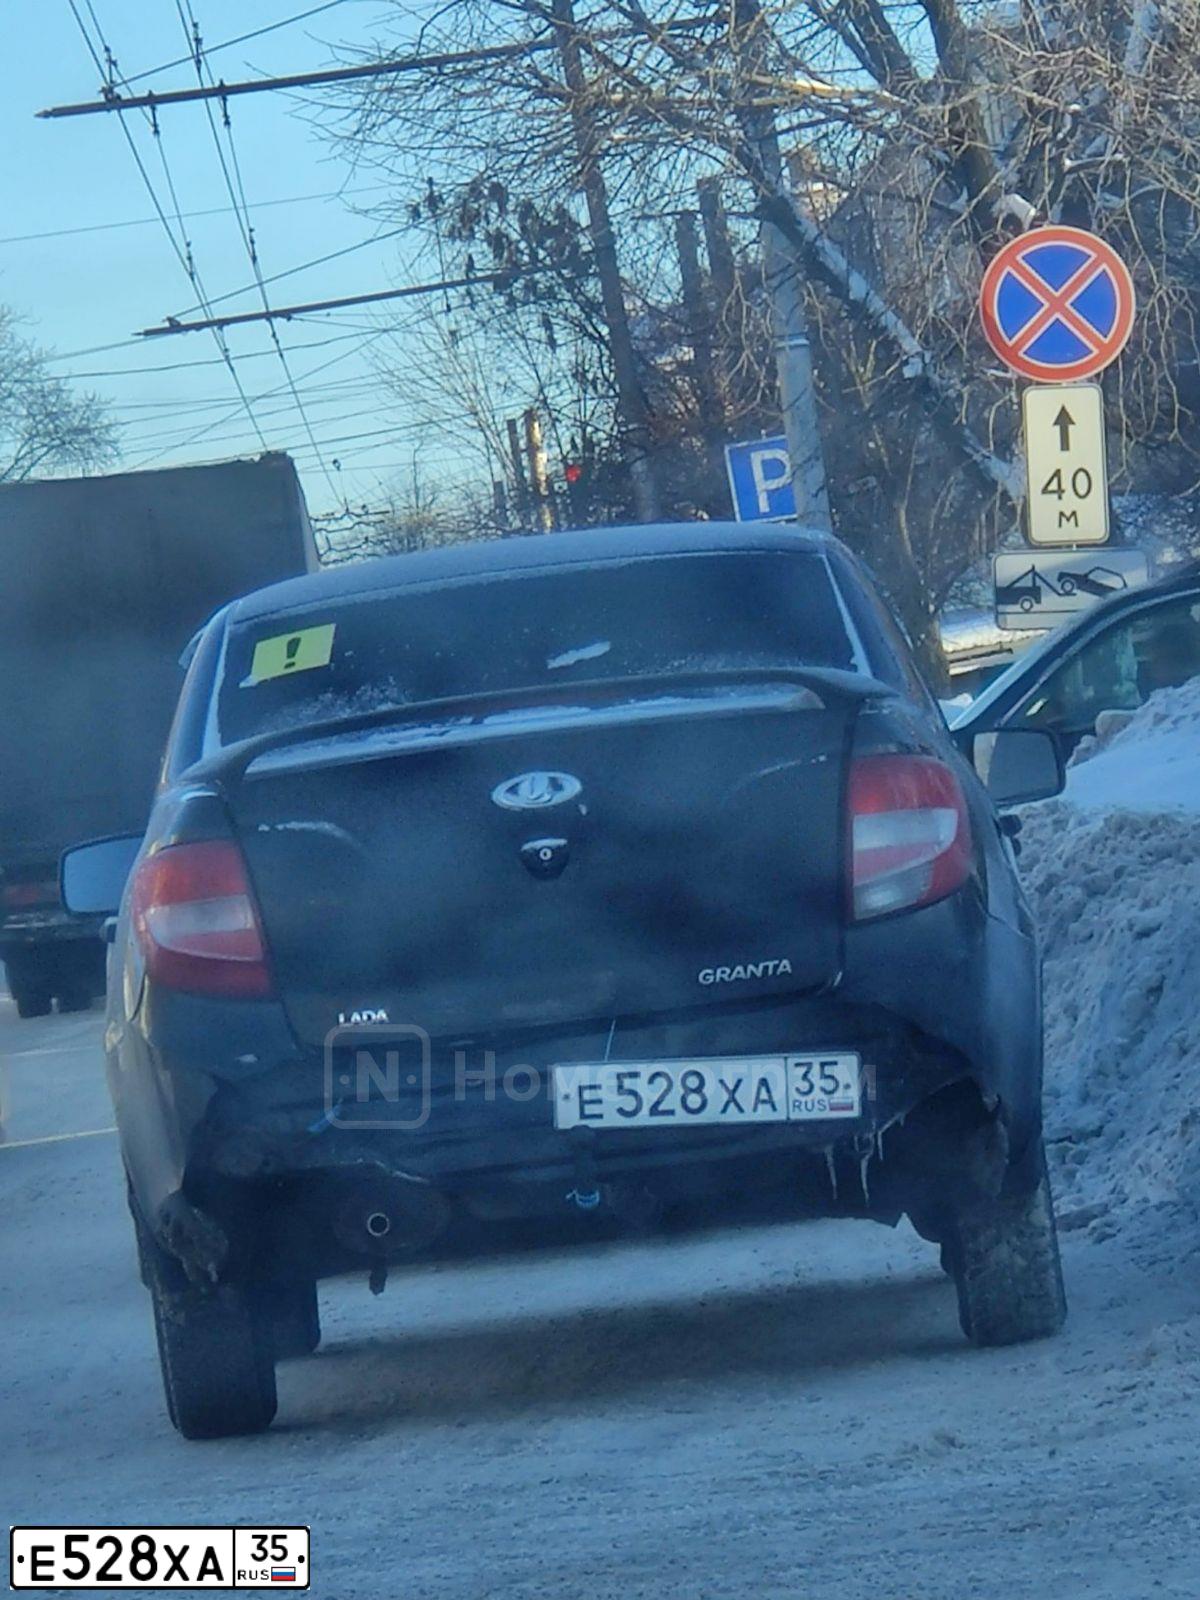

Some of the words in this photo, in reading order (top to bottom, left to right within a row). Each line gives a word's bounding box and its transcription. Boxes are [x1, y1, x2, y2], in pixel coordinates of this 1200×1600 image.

[751, 450, 793, 513] P
[1041, 468, 1093, 500] 40
[699, 959, 792, 985] GRANTA
[338, 1009, 390, 1028] LADA
[578, 1070, 778, 1119] Е528ХА
[794, 1061, 839, 1096] 35
[792, 1098, 827, 1112] RUS
